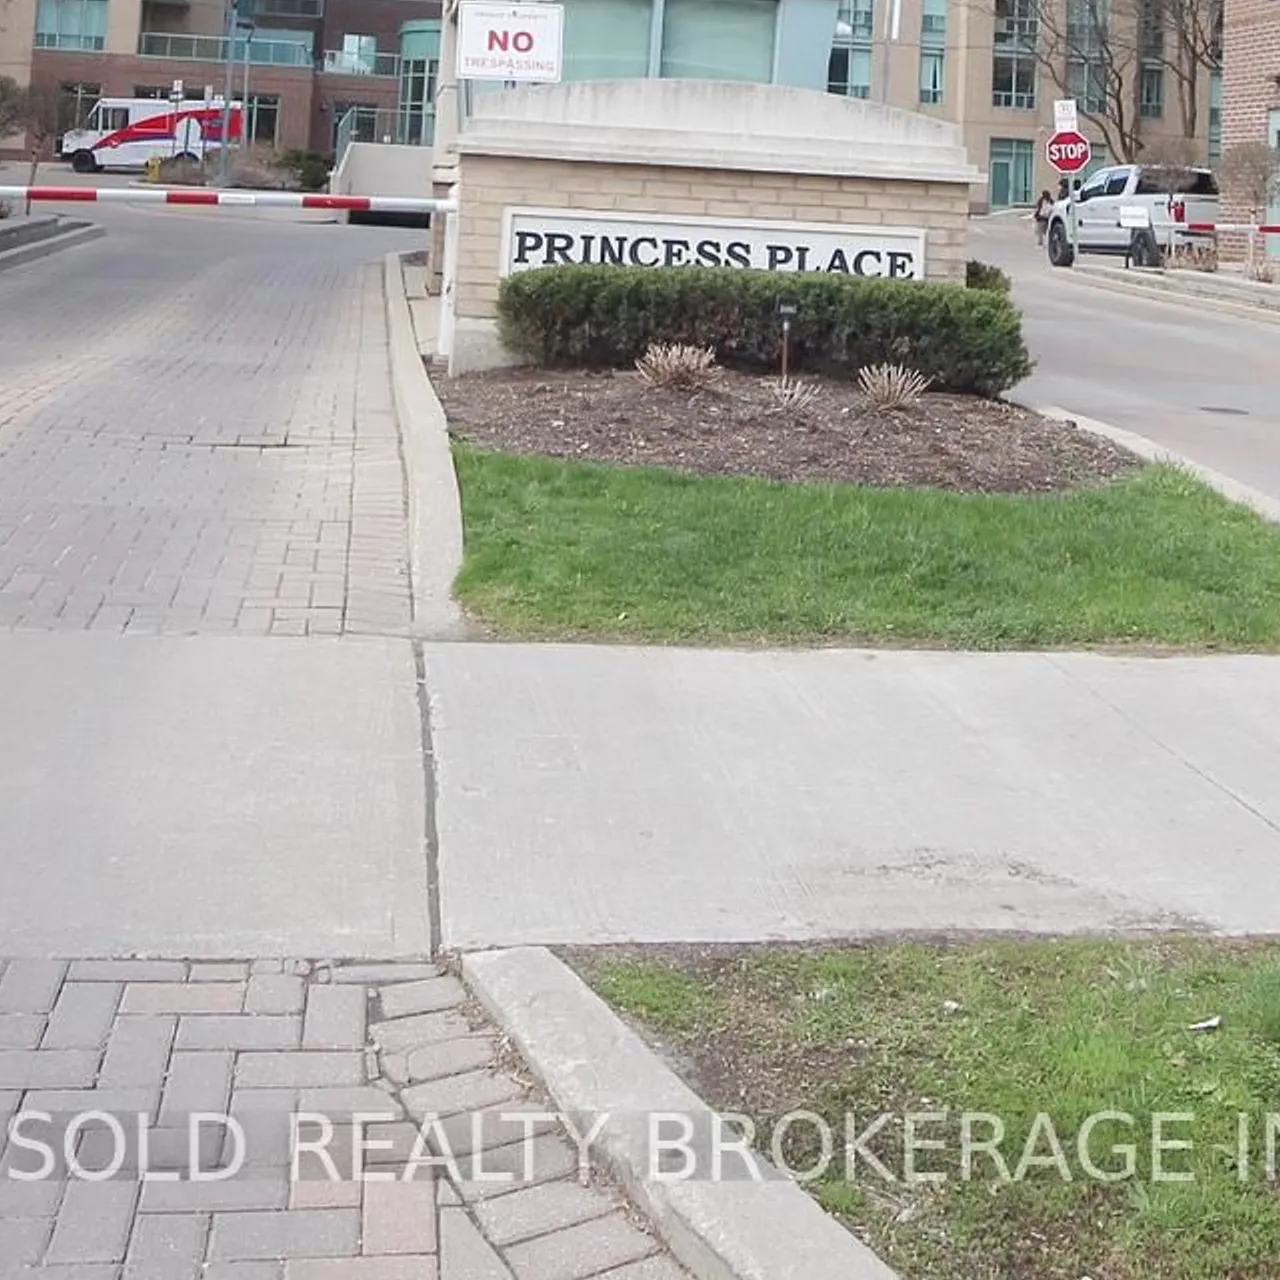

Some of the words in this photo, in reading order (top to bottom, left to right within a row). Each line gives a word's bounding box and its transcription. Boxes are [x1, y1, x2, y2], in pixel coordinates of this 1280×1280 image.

[487, 30, 534, 53] NO
[464, 56, 555, 72] TRESPASSING
[1050, 141, 1087, 160] STOP
[513, 230, 751, 268] PRINCESS
[766, 244, 914, 280] PLACE
